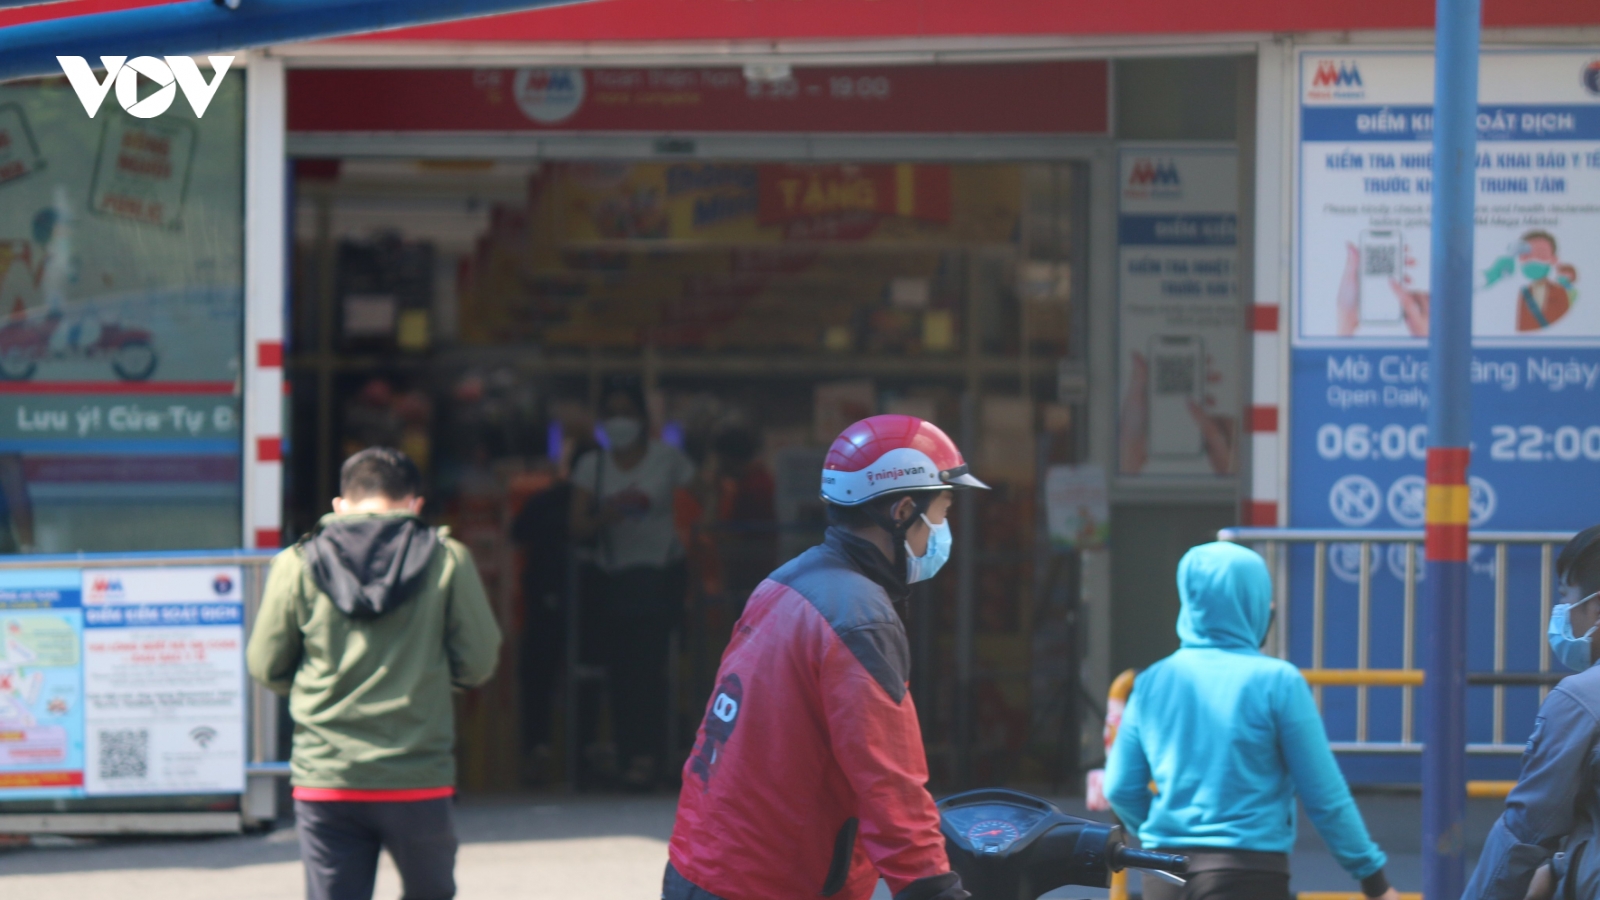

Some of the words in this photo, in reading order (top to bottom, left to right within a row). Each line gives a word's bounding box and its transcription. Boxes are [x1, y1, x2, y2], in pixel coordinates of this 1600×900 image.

[1476, 109, 1516, 131] OÁT
[1471, 356, 1519, 391] àng
[1327, 386, 1377, 409] Open
[1383, 386, 1429, 409] Daily
[1317, 424, 1428, 460] 06:00
[1490, 424, 1600, 460] 22:00
[875, 466, 925, 480] ninjavan
